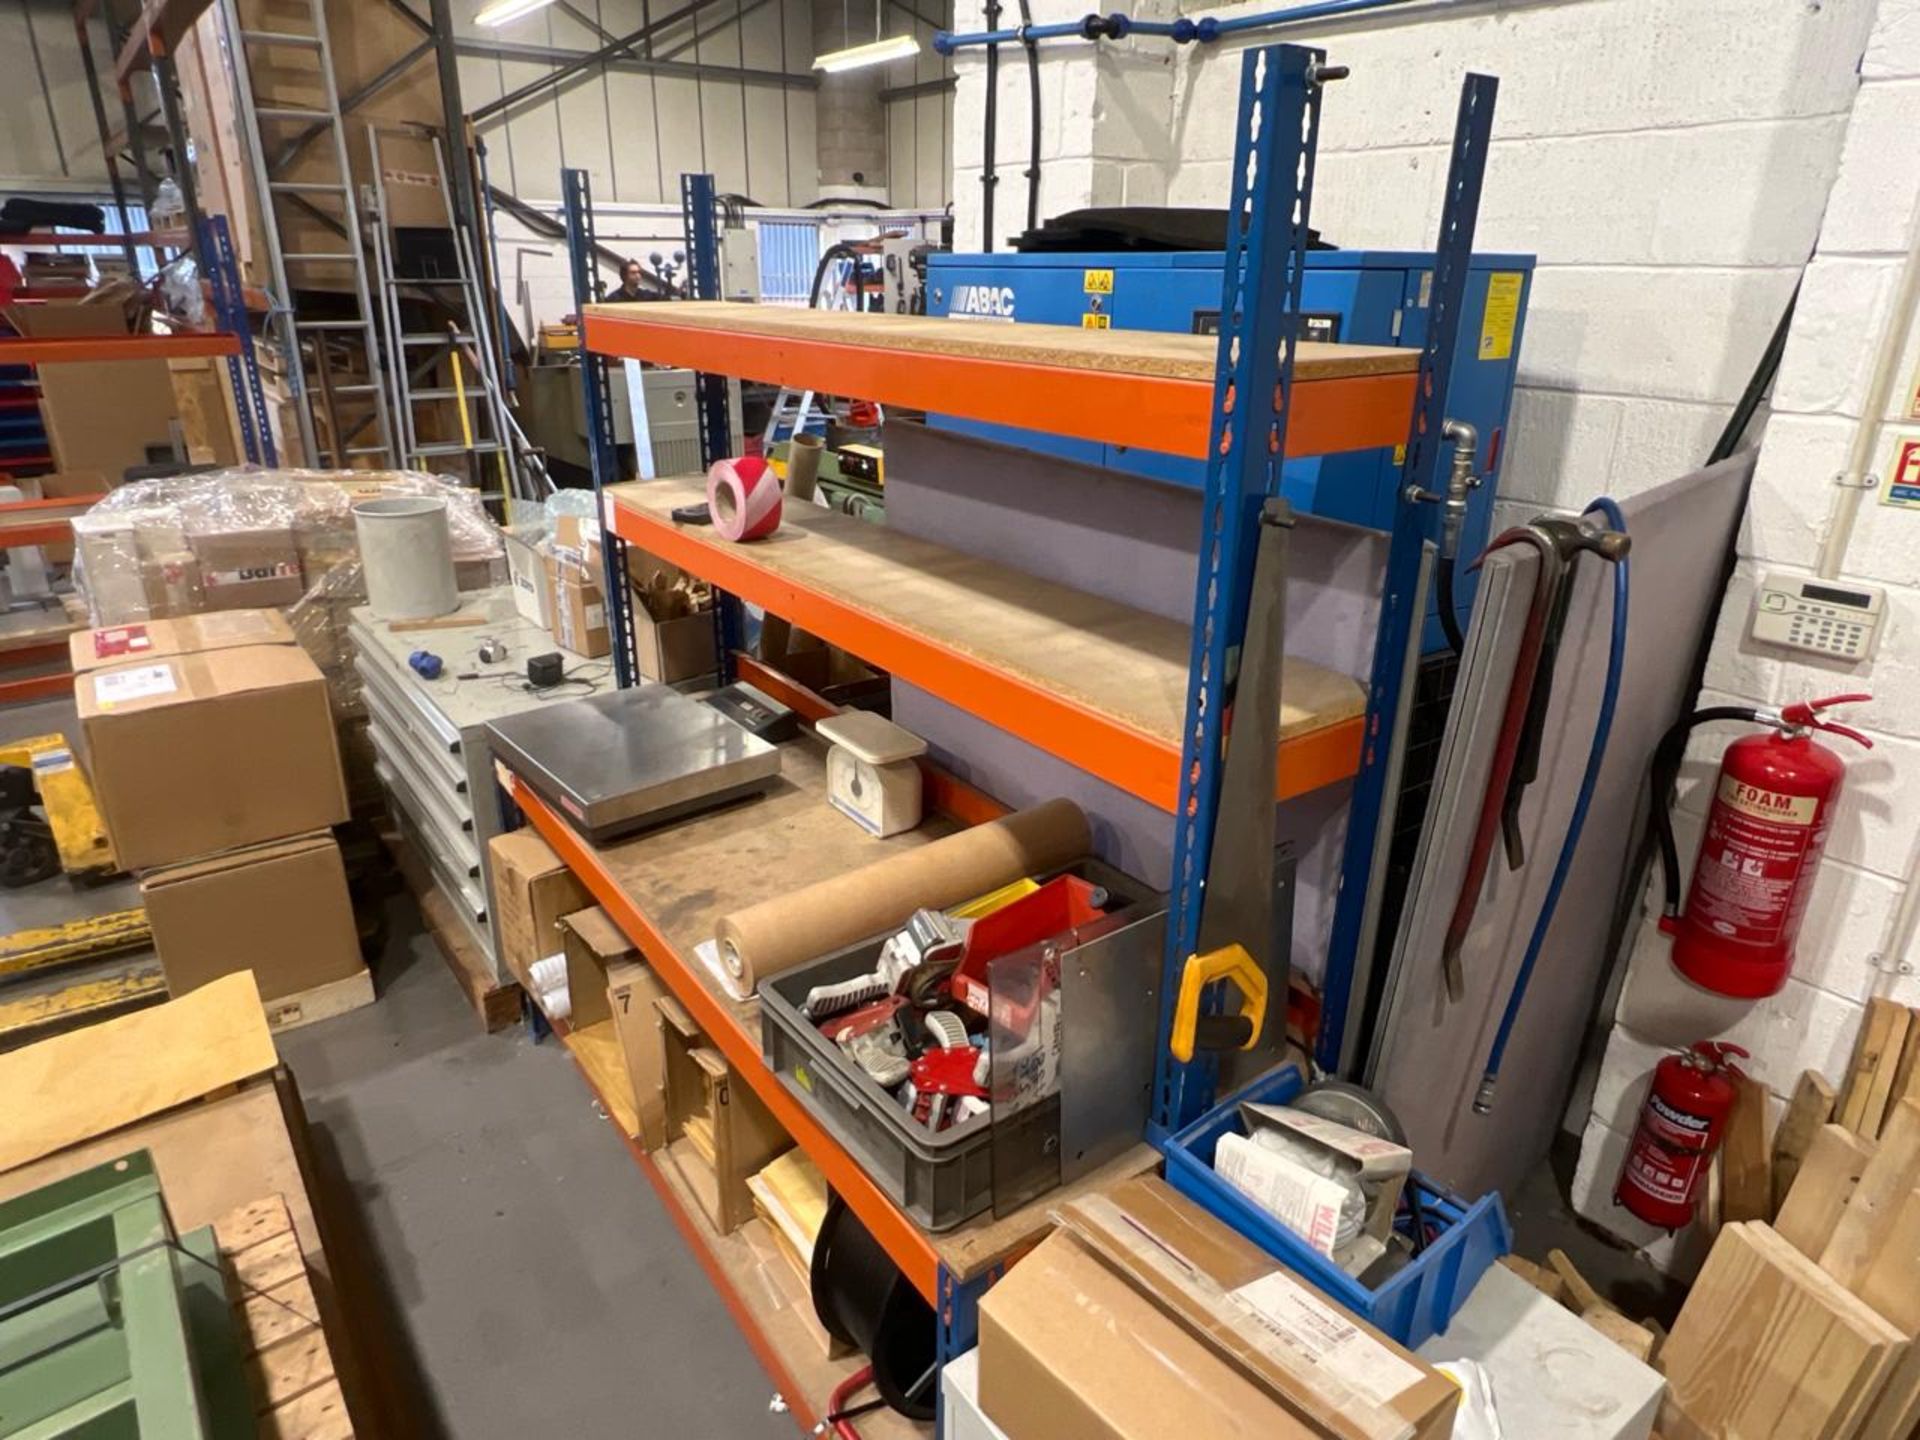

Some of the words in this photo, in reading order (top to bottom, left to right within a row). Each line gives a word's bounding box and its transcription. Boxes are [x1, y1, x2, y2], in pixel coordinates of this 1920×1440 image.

[965, 286, 1015, 316] ABAC
[1736, 784, 1792, 810] FOAM
[617, 993, 631, 1014] 7
[1649, 1094, 1709, 1130] Powder
